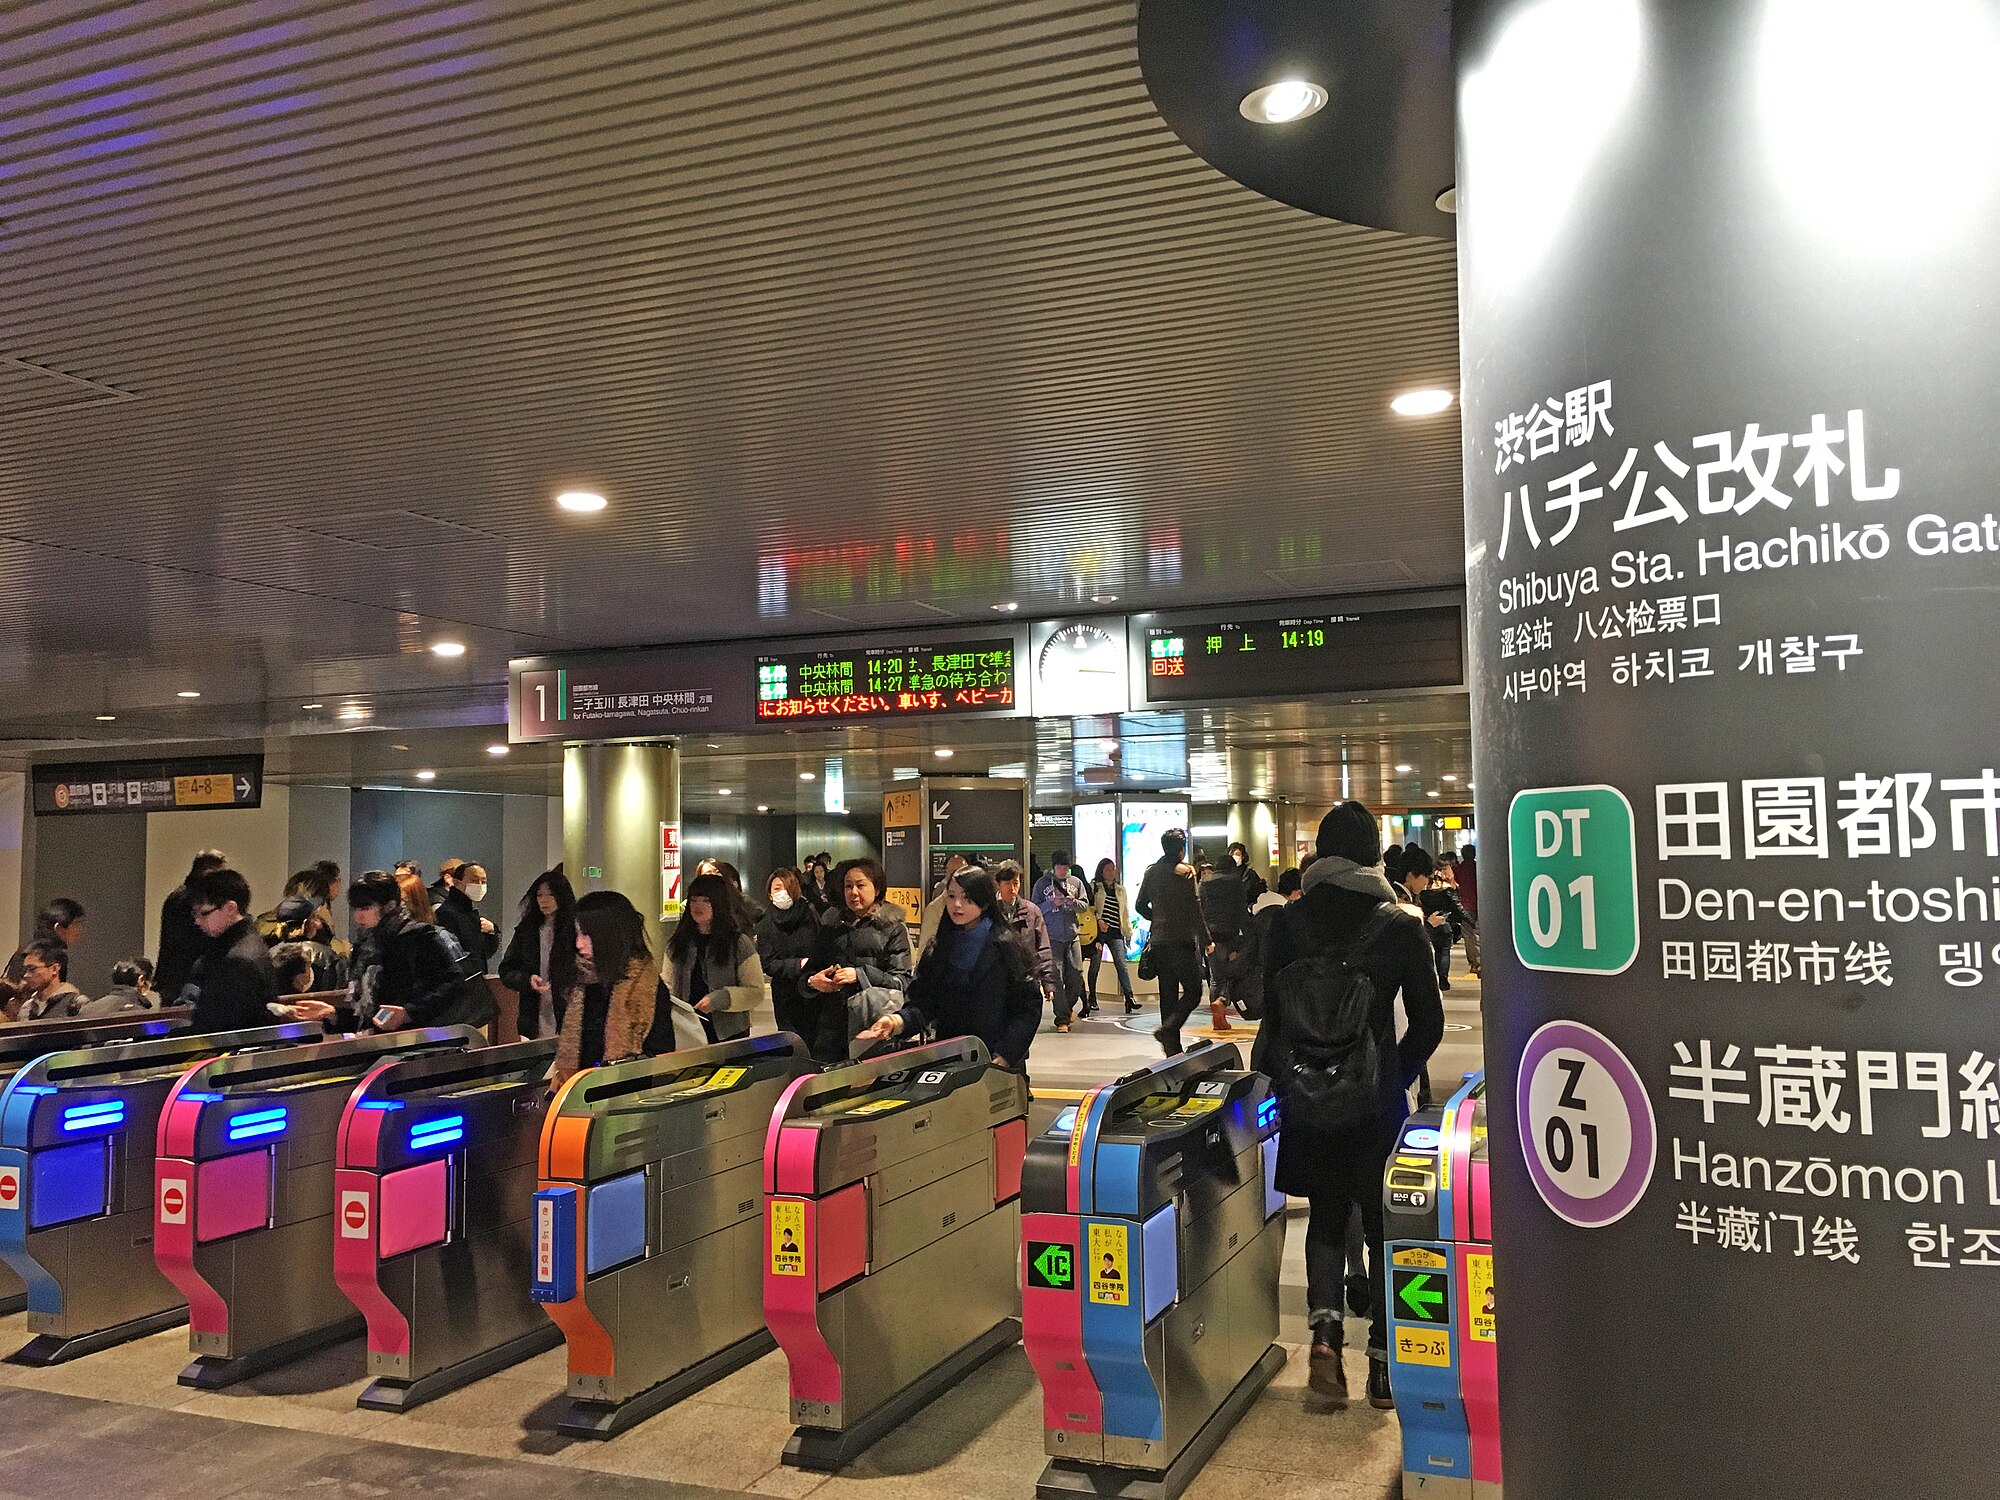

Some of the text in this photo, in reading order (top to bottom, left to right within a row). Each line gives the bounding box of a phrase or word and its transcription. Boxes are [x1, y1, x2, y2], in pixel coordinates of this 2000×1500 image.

[1494, 379, 1615, 476] 渋谷駅
[1497, 409, 1901, 562] ハチ公改札
[1498, 513, 2000, 615] Shibuya Sta. Hachikō Gat
[1573, 593, 1721, 643] 八公检票口
[1281, 629, 1324, 649] 14:19
[799, 661, 853, 681] 中央林間
[867, 658, 903, 675] 14:20
[1152, 656, 1185, 676] 回送
[1502, 633, 1864, 704] 시부야역 하치코 개찰구
[799, 679, 854, 697] 中央林間
[867, 675, 903, 693] 14:27
[908, 668, 1012, 691] 準急の待ち合わ
[534, 685, 545, 722] 1
[573, 691, 713, 711] 二子玉川 長津田 中央林間 方面
[758, 686, 1013, 717] にお知らせください。車いす、ベビーカ
[573, 712, 581, 720] for
[191, 778, 212, 795] 4-8
[1655, 768, 2000, 861] 田園都市
[935, 823, 943, 844] 1
[1535, 808, 1590, 859] DT
[1658, 875, 2000, 923] Den-en-toshi
[1527, 873, 1598, 951] 01
[1661, 939, 2000, 987] 田园都市线 뎅
[924, 1072, 938, 1083] 6
[1556, 1058, 1587, 1111] Z
[1544, 1115, 1600, 1180] 01
[1672, 1138, 1965, 1205] Hanzōmon
[1675, 1200, 1861, 1265] 半藏门线
[774, 1254, 802, 1264] 四谷学院
[1047, 1254, 1068, 1277] IC
[1409, 1251, 1430, 1259] うらが
[1093, 1281, 1125, 1292] 四谷学院
[1474, 1317, 1496, 1327] 四谷
[1399, 1338, 1446, 1356] きっぷ
[376, 1355, 401, 1366] 3 4
[577, 1377, 604, 1388] 4 5
[800, 1402, 831, 1415] 5 6
[1057, 1432, 1151, 1455] 6 7
[1418, 1477, 1426, 1489] 7
